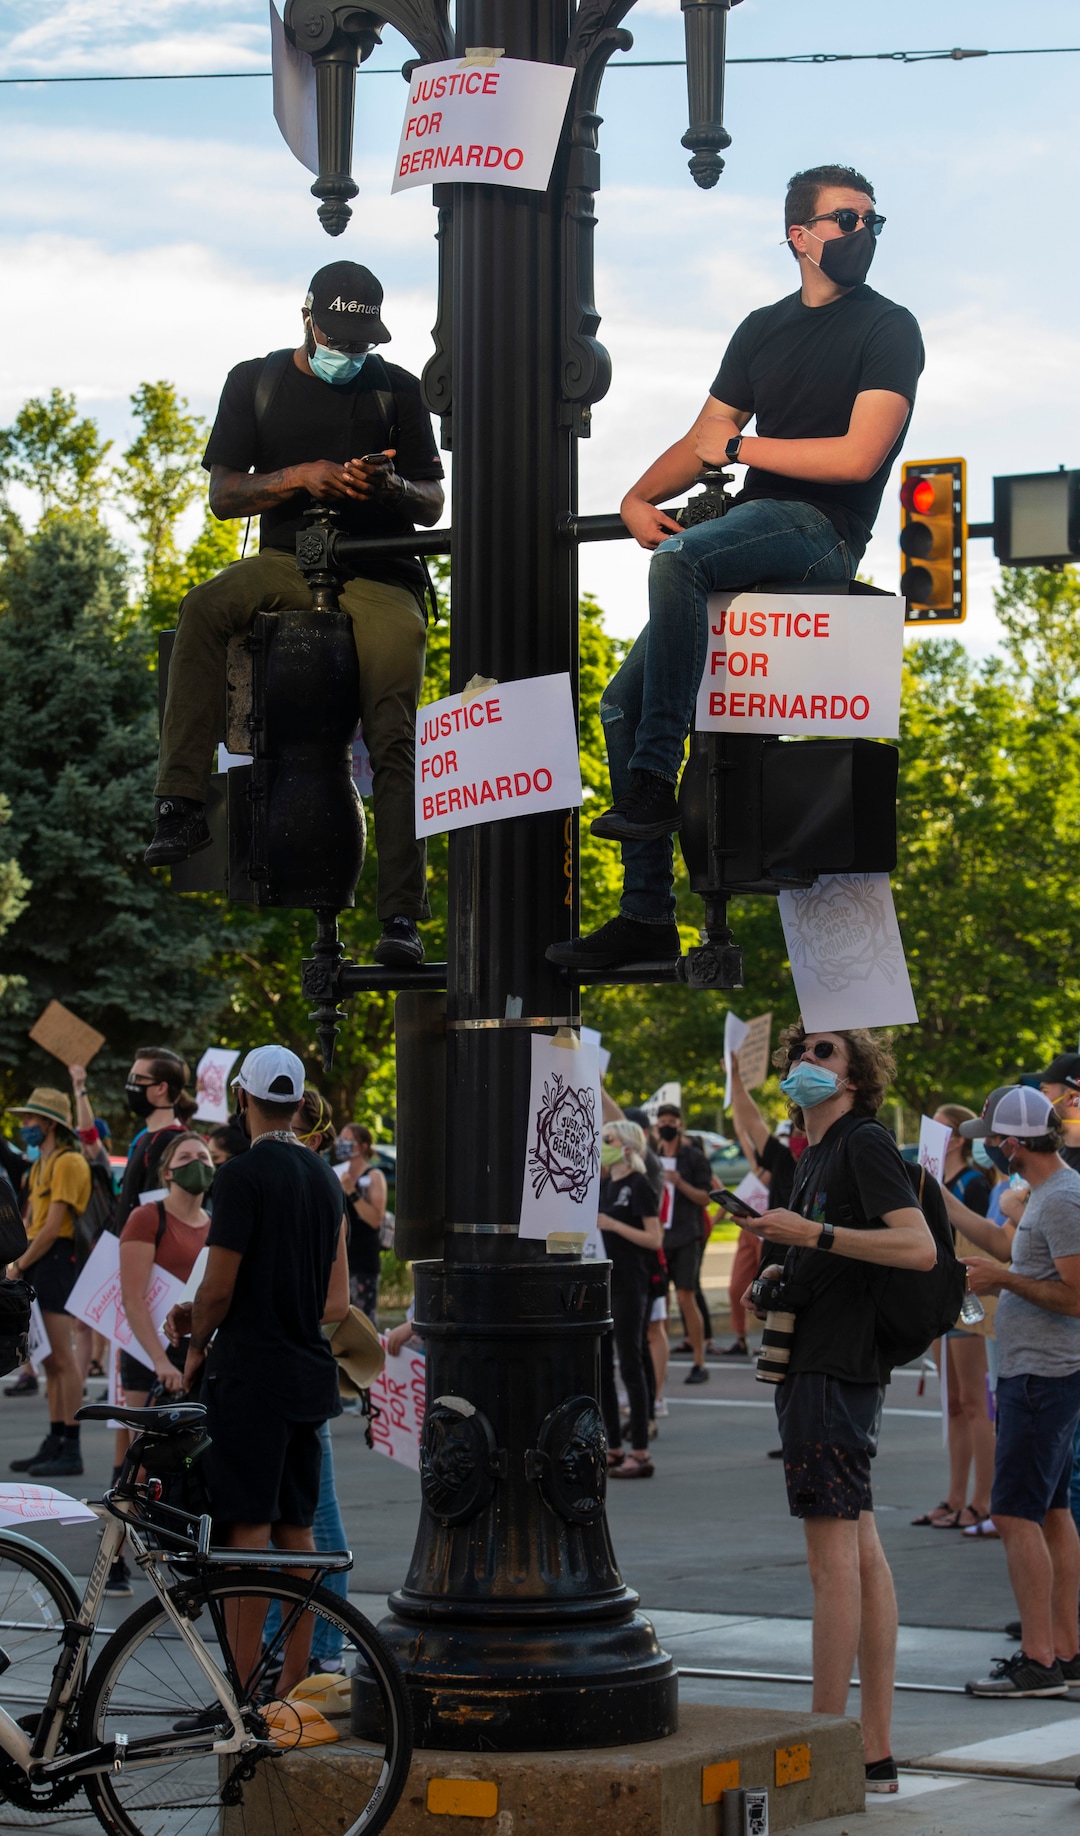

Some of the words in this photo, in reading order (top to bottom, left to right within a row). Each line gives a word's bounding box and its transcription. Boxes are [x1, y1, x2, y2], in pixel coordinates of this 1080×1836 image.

[412, 72, 500, 104] JUSTICE
[405, 112, 443, 141] FOR
[399, 145, 524, 177] BERNARDO
[711, 611, 830, 638] JUSTICE
[710, 651, 769, 677] FOR
[708, 692, 870, 721] BERNARDO
[420, 699, 502, 746] JUSTICE
[421, 750, 458, 783] FOR
[423, 768, 552, 821] BERNARDO
[561, 1116, 587, 1143] JUSTICE
[563, 1128, 580, 1147] FOR
[552, 1136, 586, 1169] BERNARDO
[387, 1378, 412, 1433] FOR
[307, 1604, 350, 1635] american
[98, 1686, 112, 1718] VICTORY
[365, 1785, 384, 1816] VICTORY
